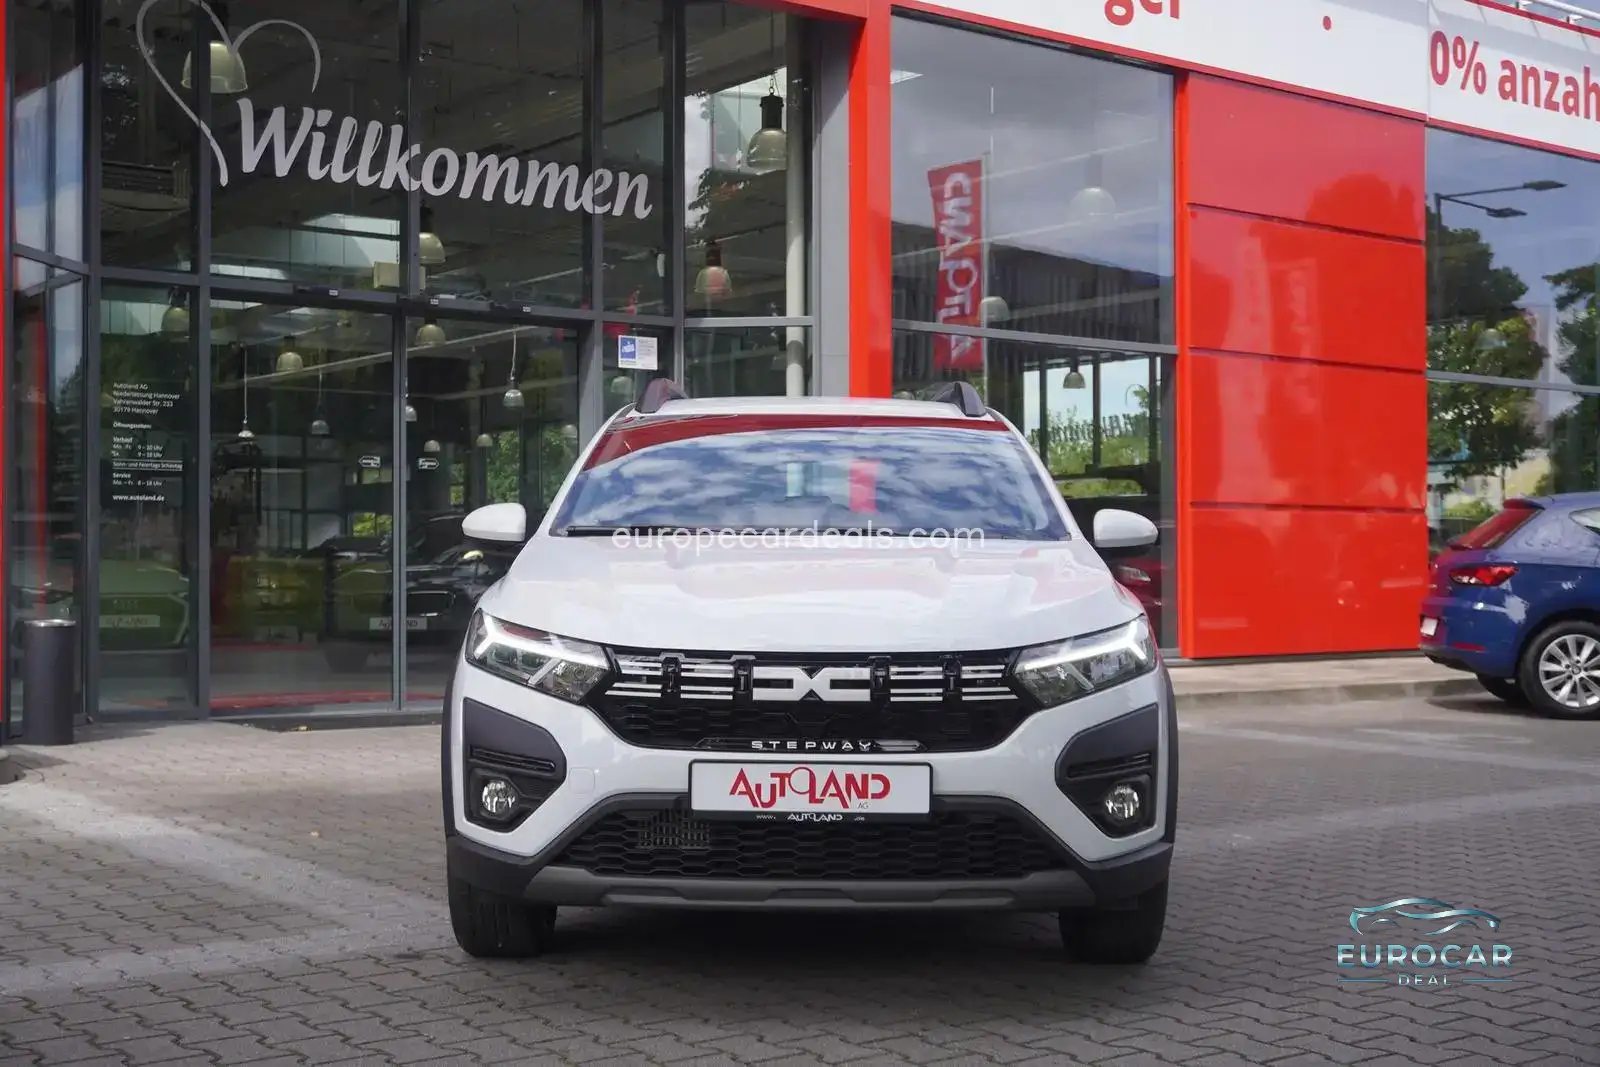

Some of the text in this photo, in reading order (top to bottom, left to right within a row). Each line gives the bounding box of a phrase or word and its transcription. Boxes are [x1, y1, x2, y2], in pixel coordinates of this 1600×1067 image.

[1429, 30, 1487, 94] 0%
[237, 97, 653, 219] Willkommen
[153, 392, 180, 400] Hannover
[131, 407, 159, 415] Hannover
[751, 740, 872, 751] STEPWAY
[729, 766, 891, 809] AUTOLAND
[857, 801, 869, 810] AG
